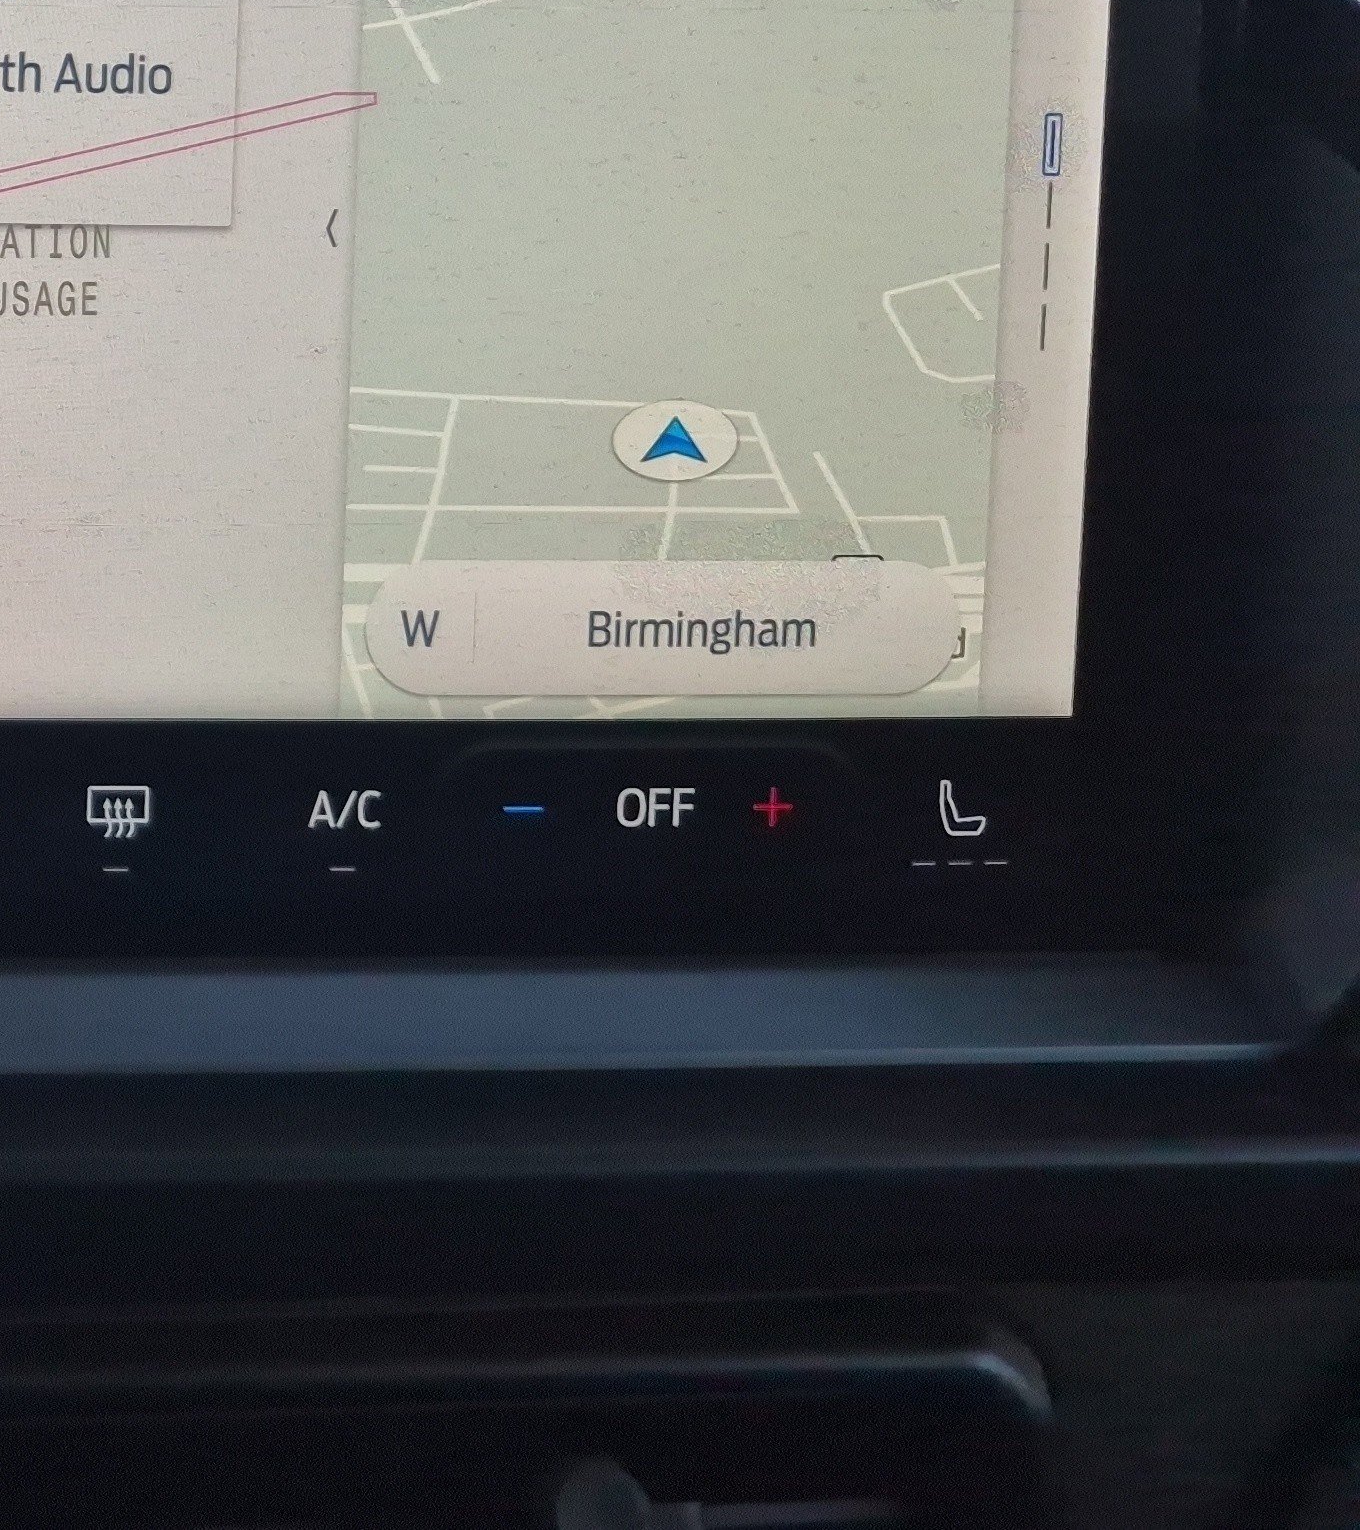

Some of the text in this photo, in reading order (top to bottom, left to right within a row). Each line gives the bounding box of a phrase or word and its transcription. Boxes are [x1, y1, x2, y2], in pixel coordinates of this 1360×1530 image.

[54, 53, 173, 95] Audio
[401, 610, 817, 654] W Birmingham
[308, 790, 382, 830] A/C
[616, 787, 696, 829] OFF
